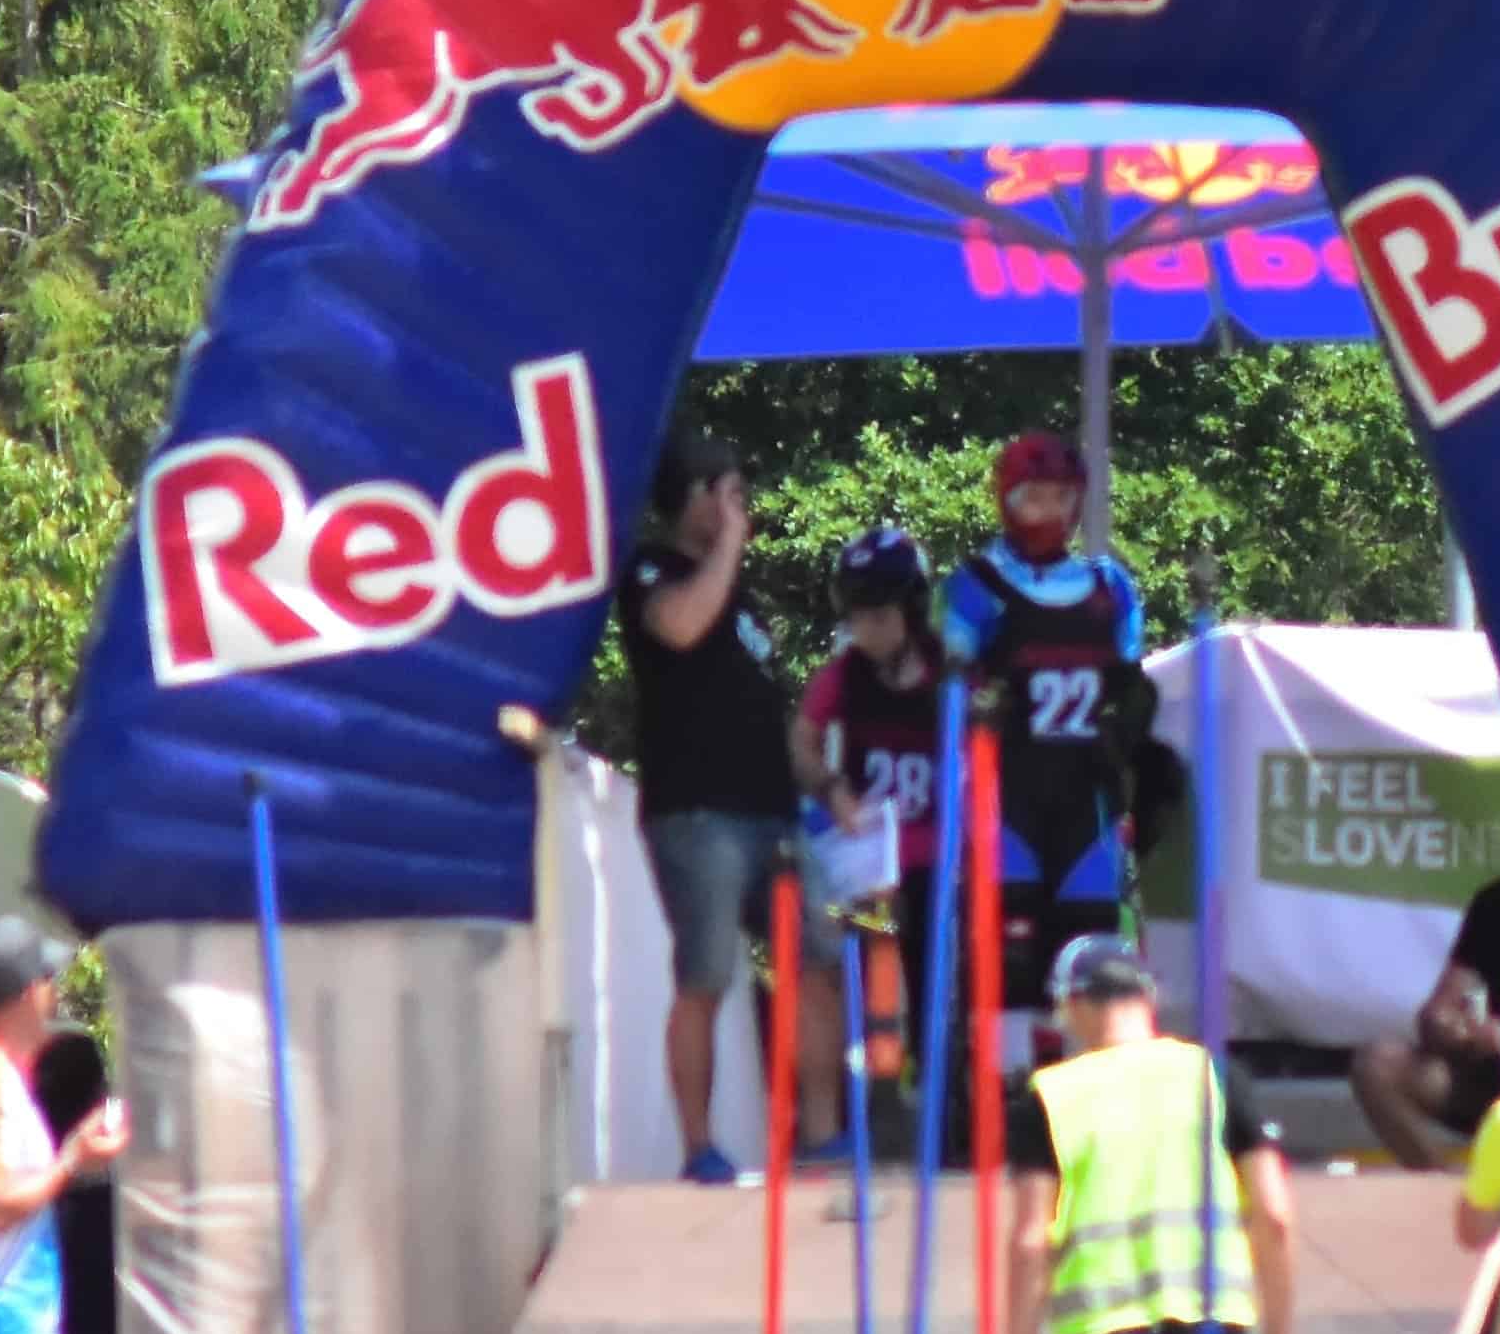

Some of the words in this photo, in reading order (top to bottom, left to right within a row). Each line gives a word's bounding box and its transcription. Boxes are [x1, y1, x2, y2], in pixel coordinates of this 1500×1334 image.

[150, 367, 598, 670] Red
[1027, 668, 1101, 738] 22
[1268, 761, 1292, 809] I
[1306, 760, 1436, 813] FEEL
